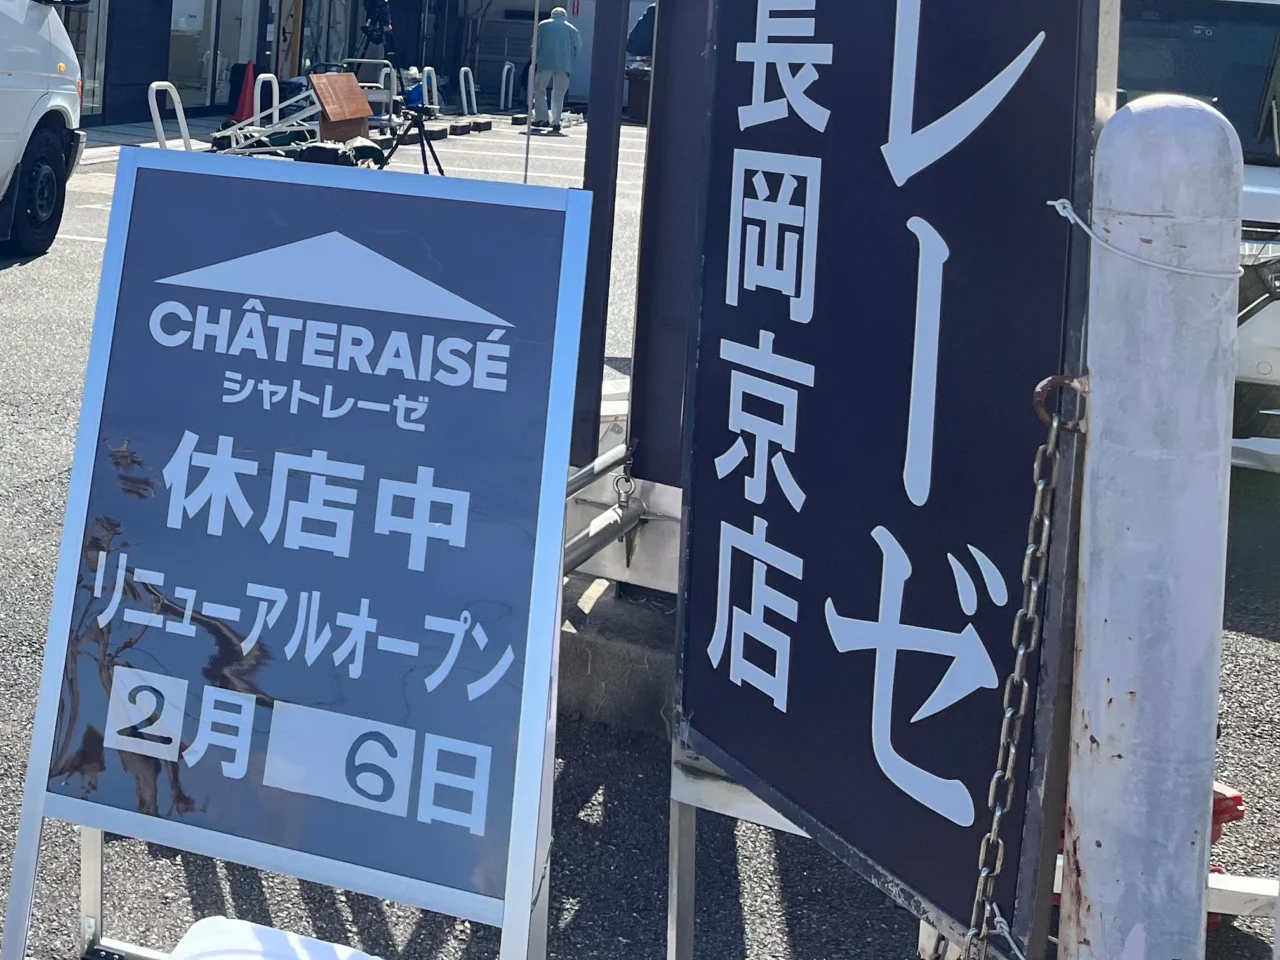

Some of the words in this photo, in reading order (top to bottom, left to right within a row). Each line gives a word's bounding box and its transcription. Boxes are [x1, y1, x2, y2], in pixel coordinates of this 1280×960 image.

[149, 297, 511, 392] CHÂTERAISÉ
[221, 370, 430, 433] シャトレーゼ
[161, 429, 472, 573] 休店中
[92, 551, 516, 704] リニューアルオープン
